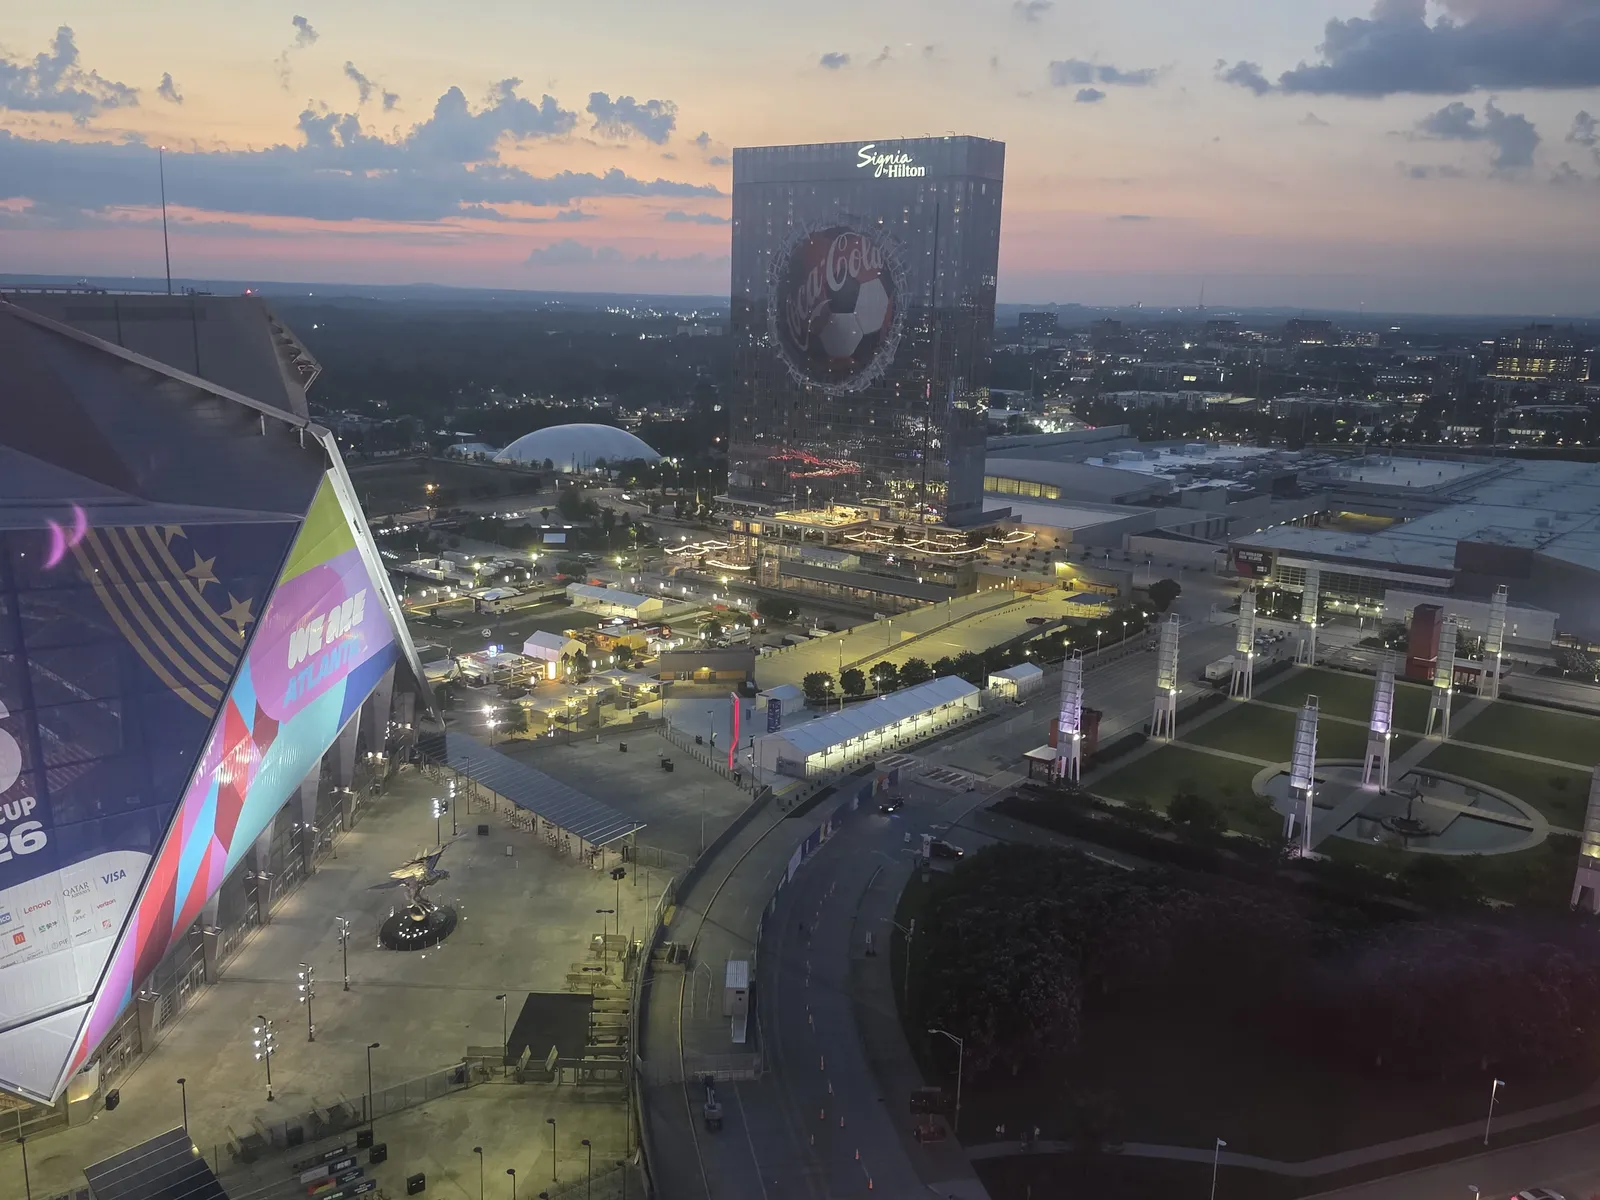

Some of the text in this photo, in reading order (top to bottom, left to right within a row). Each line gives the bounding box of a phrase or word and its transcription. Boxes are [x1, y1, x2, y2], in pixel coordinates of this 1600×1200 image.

[856, 144, 913, 178] Signia
[882, 164, 926, 178] by Hilton
[287, 588, 367, 670] WE ARE
[101, 869, 127, 885] VISA
[62, 881, 90, 898] QATAR
[23, 899, 52, 915] Lenovo
[96, 898, 117, 910] verizon
